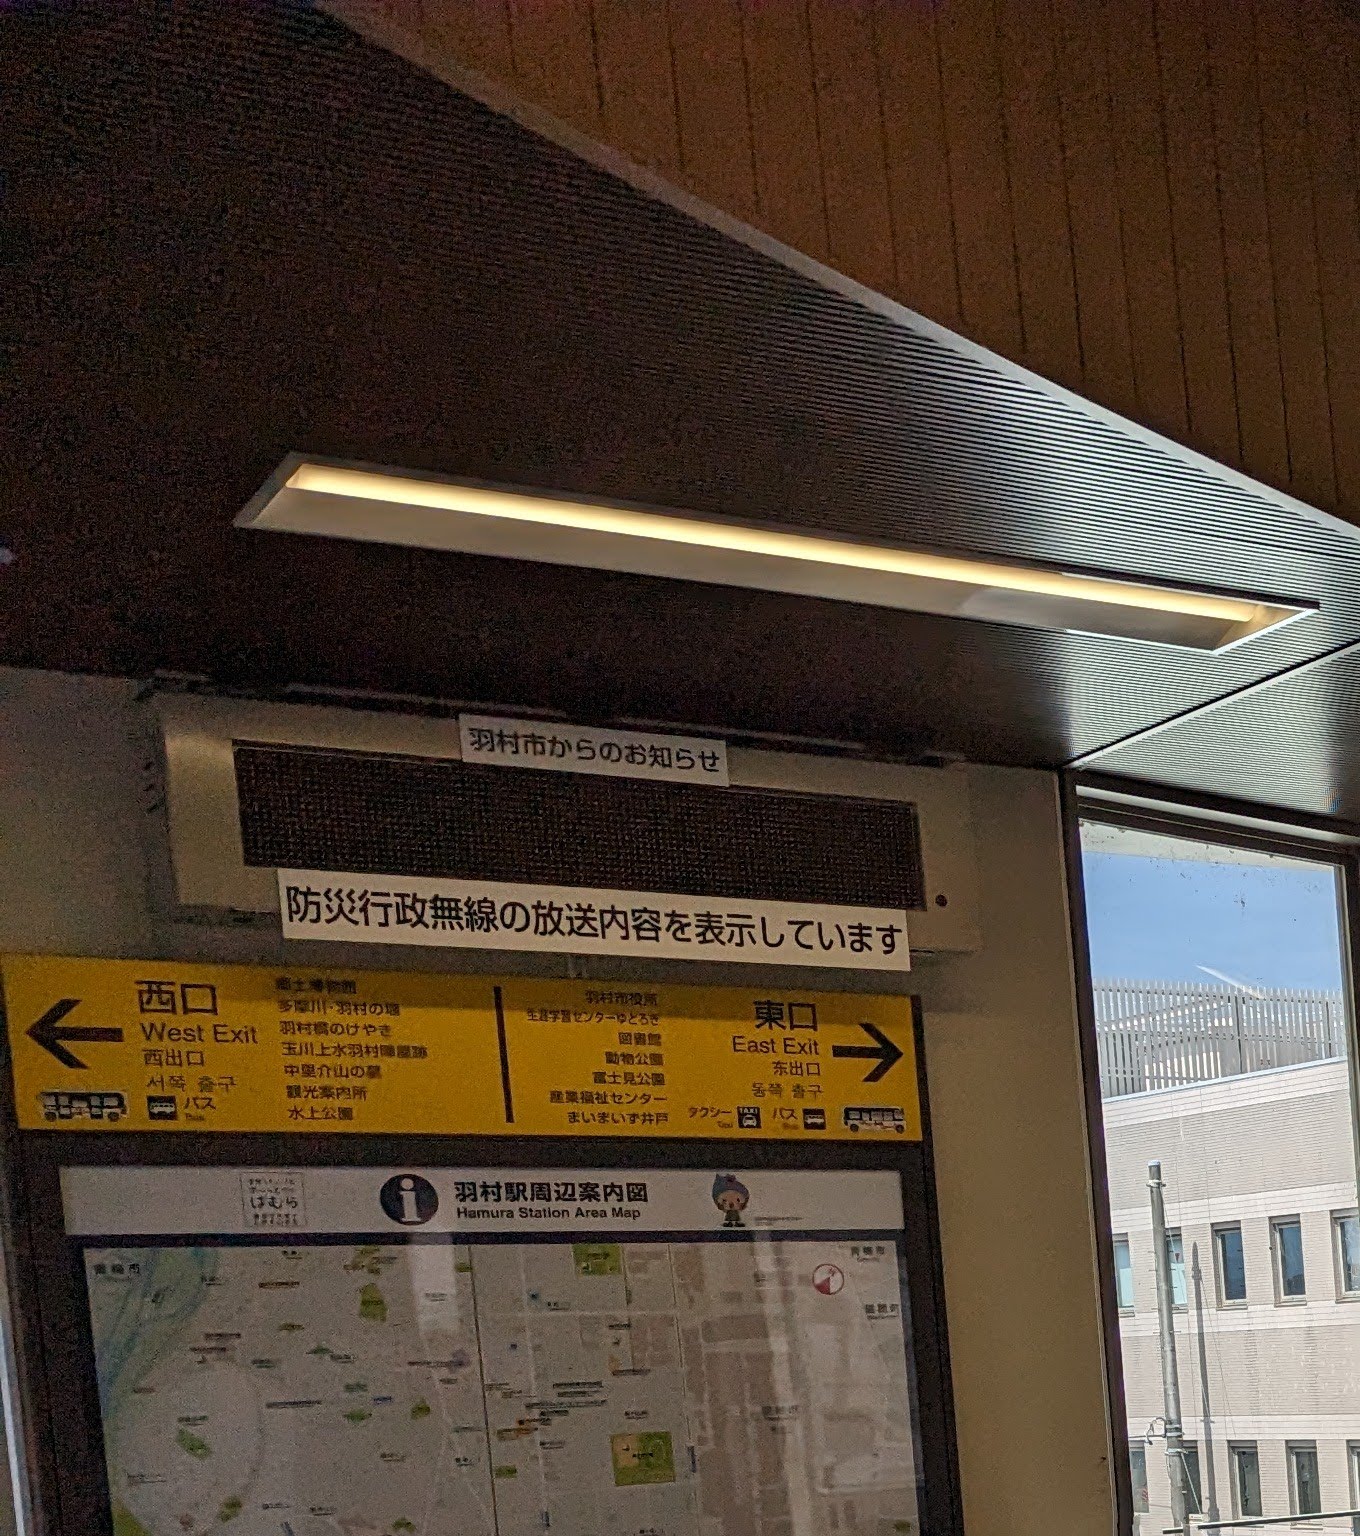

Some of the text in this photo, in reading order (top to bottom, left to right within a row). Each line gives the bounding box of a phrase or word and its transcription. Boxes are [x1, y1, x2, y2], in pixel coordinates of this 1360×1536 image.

[468, 726, 720, 773] 羽村市からのお知らせ
[286, 885, 903, 956] 防災行政無線の放送内容を表示しています
[135, 980, 218, 1016] 西口
[754, 999, 819, 1033] 東口
[141, 1022, 259, 1045] West Exit
[732, 1035, 820, 1056] East Exit
[143, 1048, 206, 1068] 西出口
[772, 1060, 821, 1077] 东出口
[591, 1071, 666, 1086] 富士見公園
[183, 1095, 217, 1111] バス
[287, 1105, 354, 1121] 水上公園
[567, 1111, 669, 1126] まいまいず井戸
[688, 1106, 733, 1120] タクシー
[772, 1107, 799, 1121] バス
[453, 1180, 649, 1204] 羽村駅周辺案内図
[456, 1206, 642, 1222] Hamura Station Area Map
